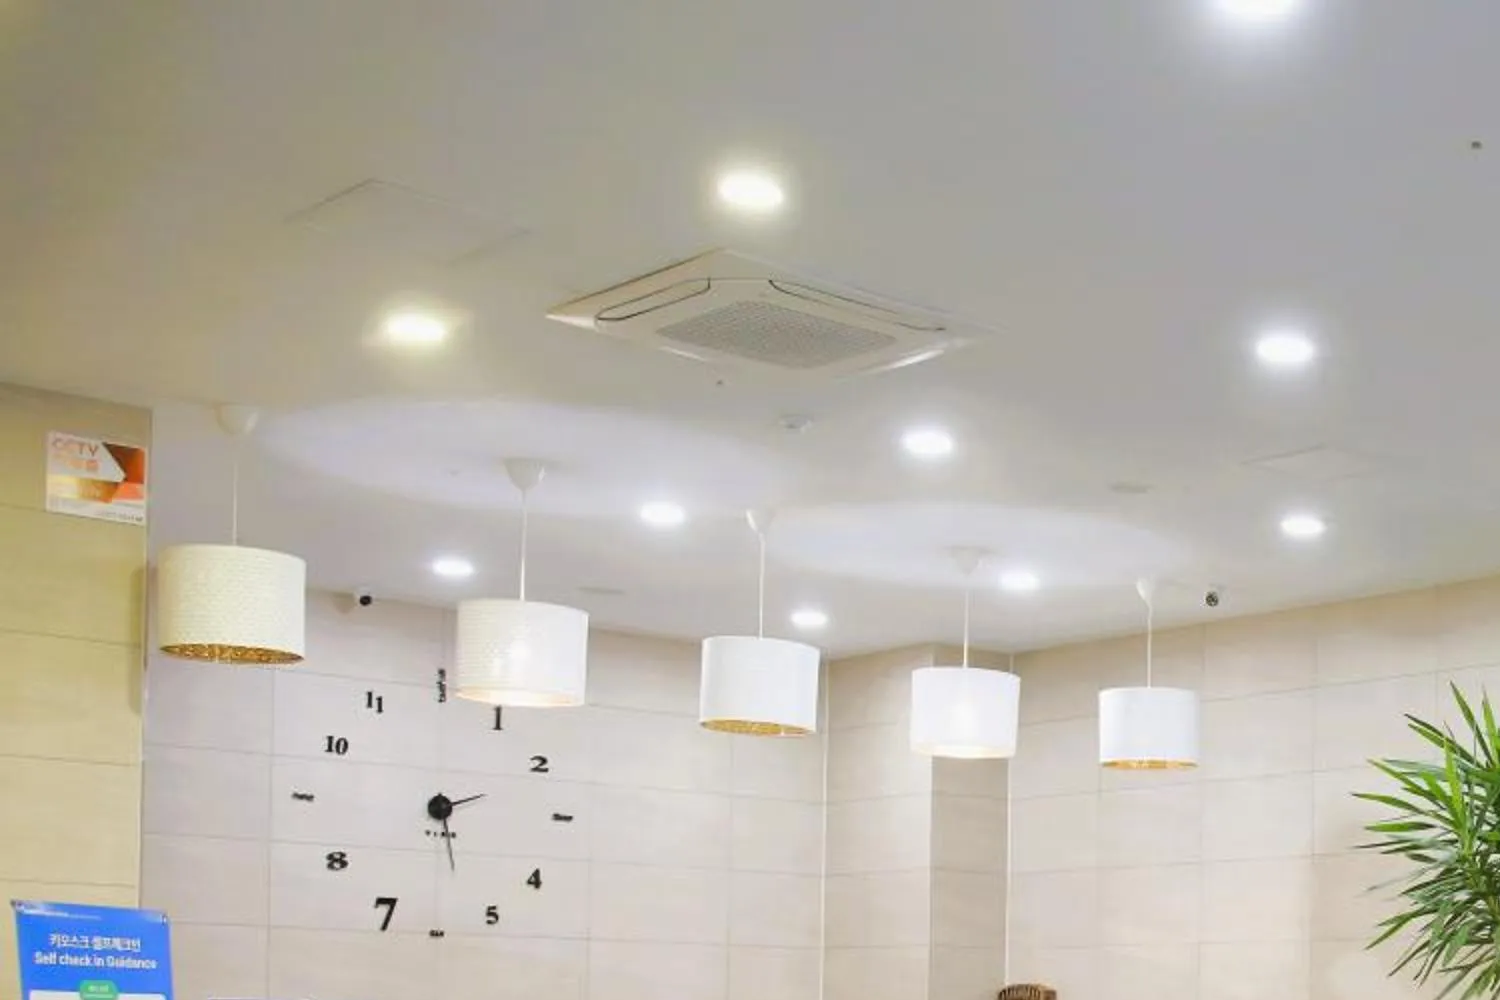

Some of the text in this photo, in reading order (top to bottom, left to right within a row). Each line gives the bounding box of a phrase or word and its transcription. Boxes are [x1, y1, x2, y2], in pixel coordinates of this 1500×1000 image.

[365, 690, 384, 714] 11
[492, 706, 504, 731] 1
[324, 735, 349, 756] 10
[530, 755, 550, 773] 2
[325, 851, 349, 871] 8
[525, 867, 543, 890] 4
[373, 896, 399, 932] 7
[485, 905, 500, 925] 5
[35, 952, 157, 969] Self check in Guidance
